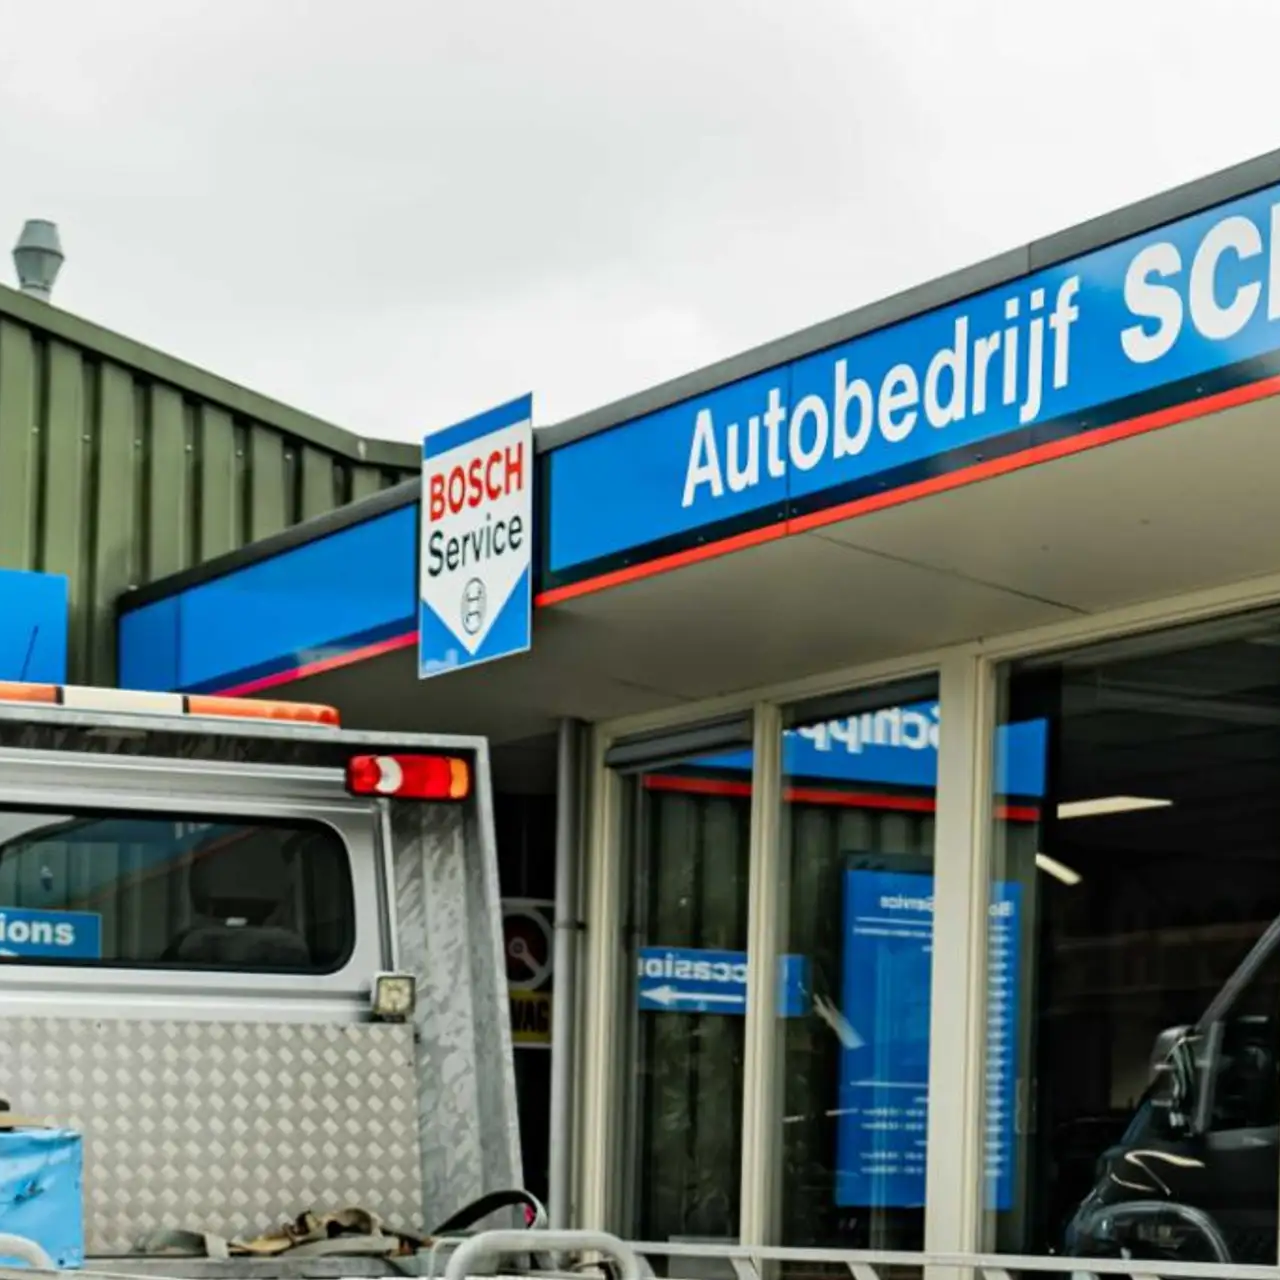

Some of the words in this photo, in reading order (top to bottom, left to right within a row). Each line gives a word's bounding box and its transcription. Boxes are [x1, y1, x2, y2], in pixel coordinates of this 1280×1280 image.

[682, 275, 1080, 507] Autobedrijf
[429, 442, 524, 522] BOSCH
[428, 512, 524, 577] Service
